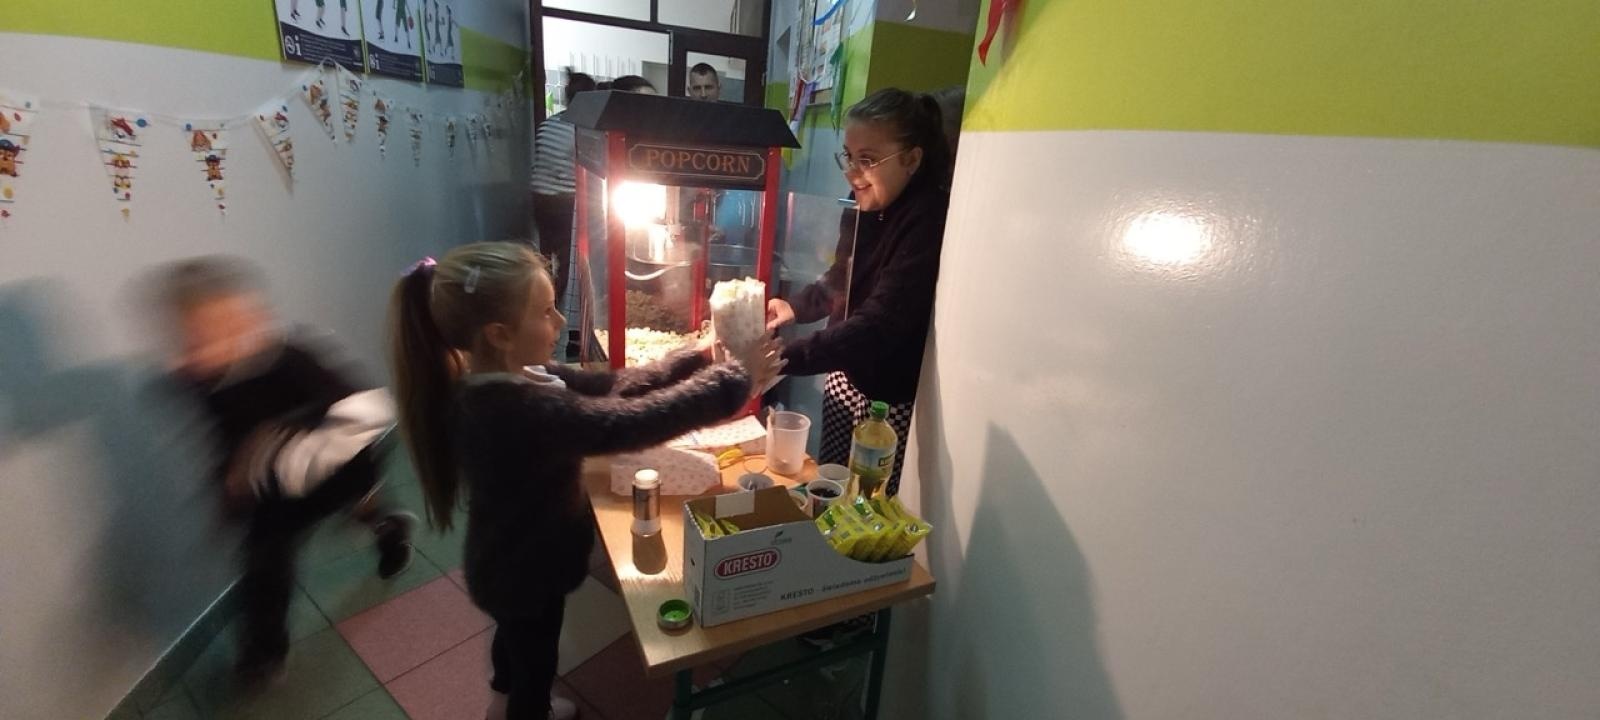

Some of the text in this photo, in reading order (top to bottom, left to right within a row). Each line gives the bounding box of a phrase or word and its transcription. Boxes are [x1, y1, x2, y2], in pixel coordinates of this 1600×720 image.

[645, 149, 750, 173] POPCORN
[723, 552, 772, 575] KRESTO
[780, 588, 814, 601] KRESTO
